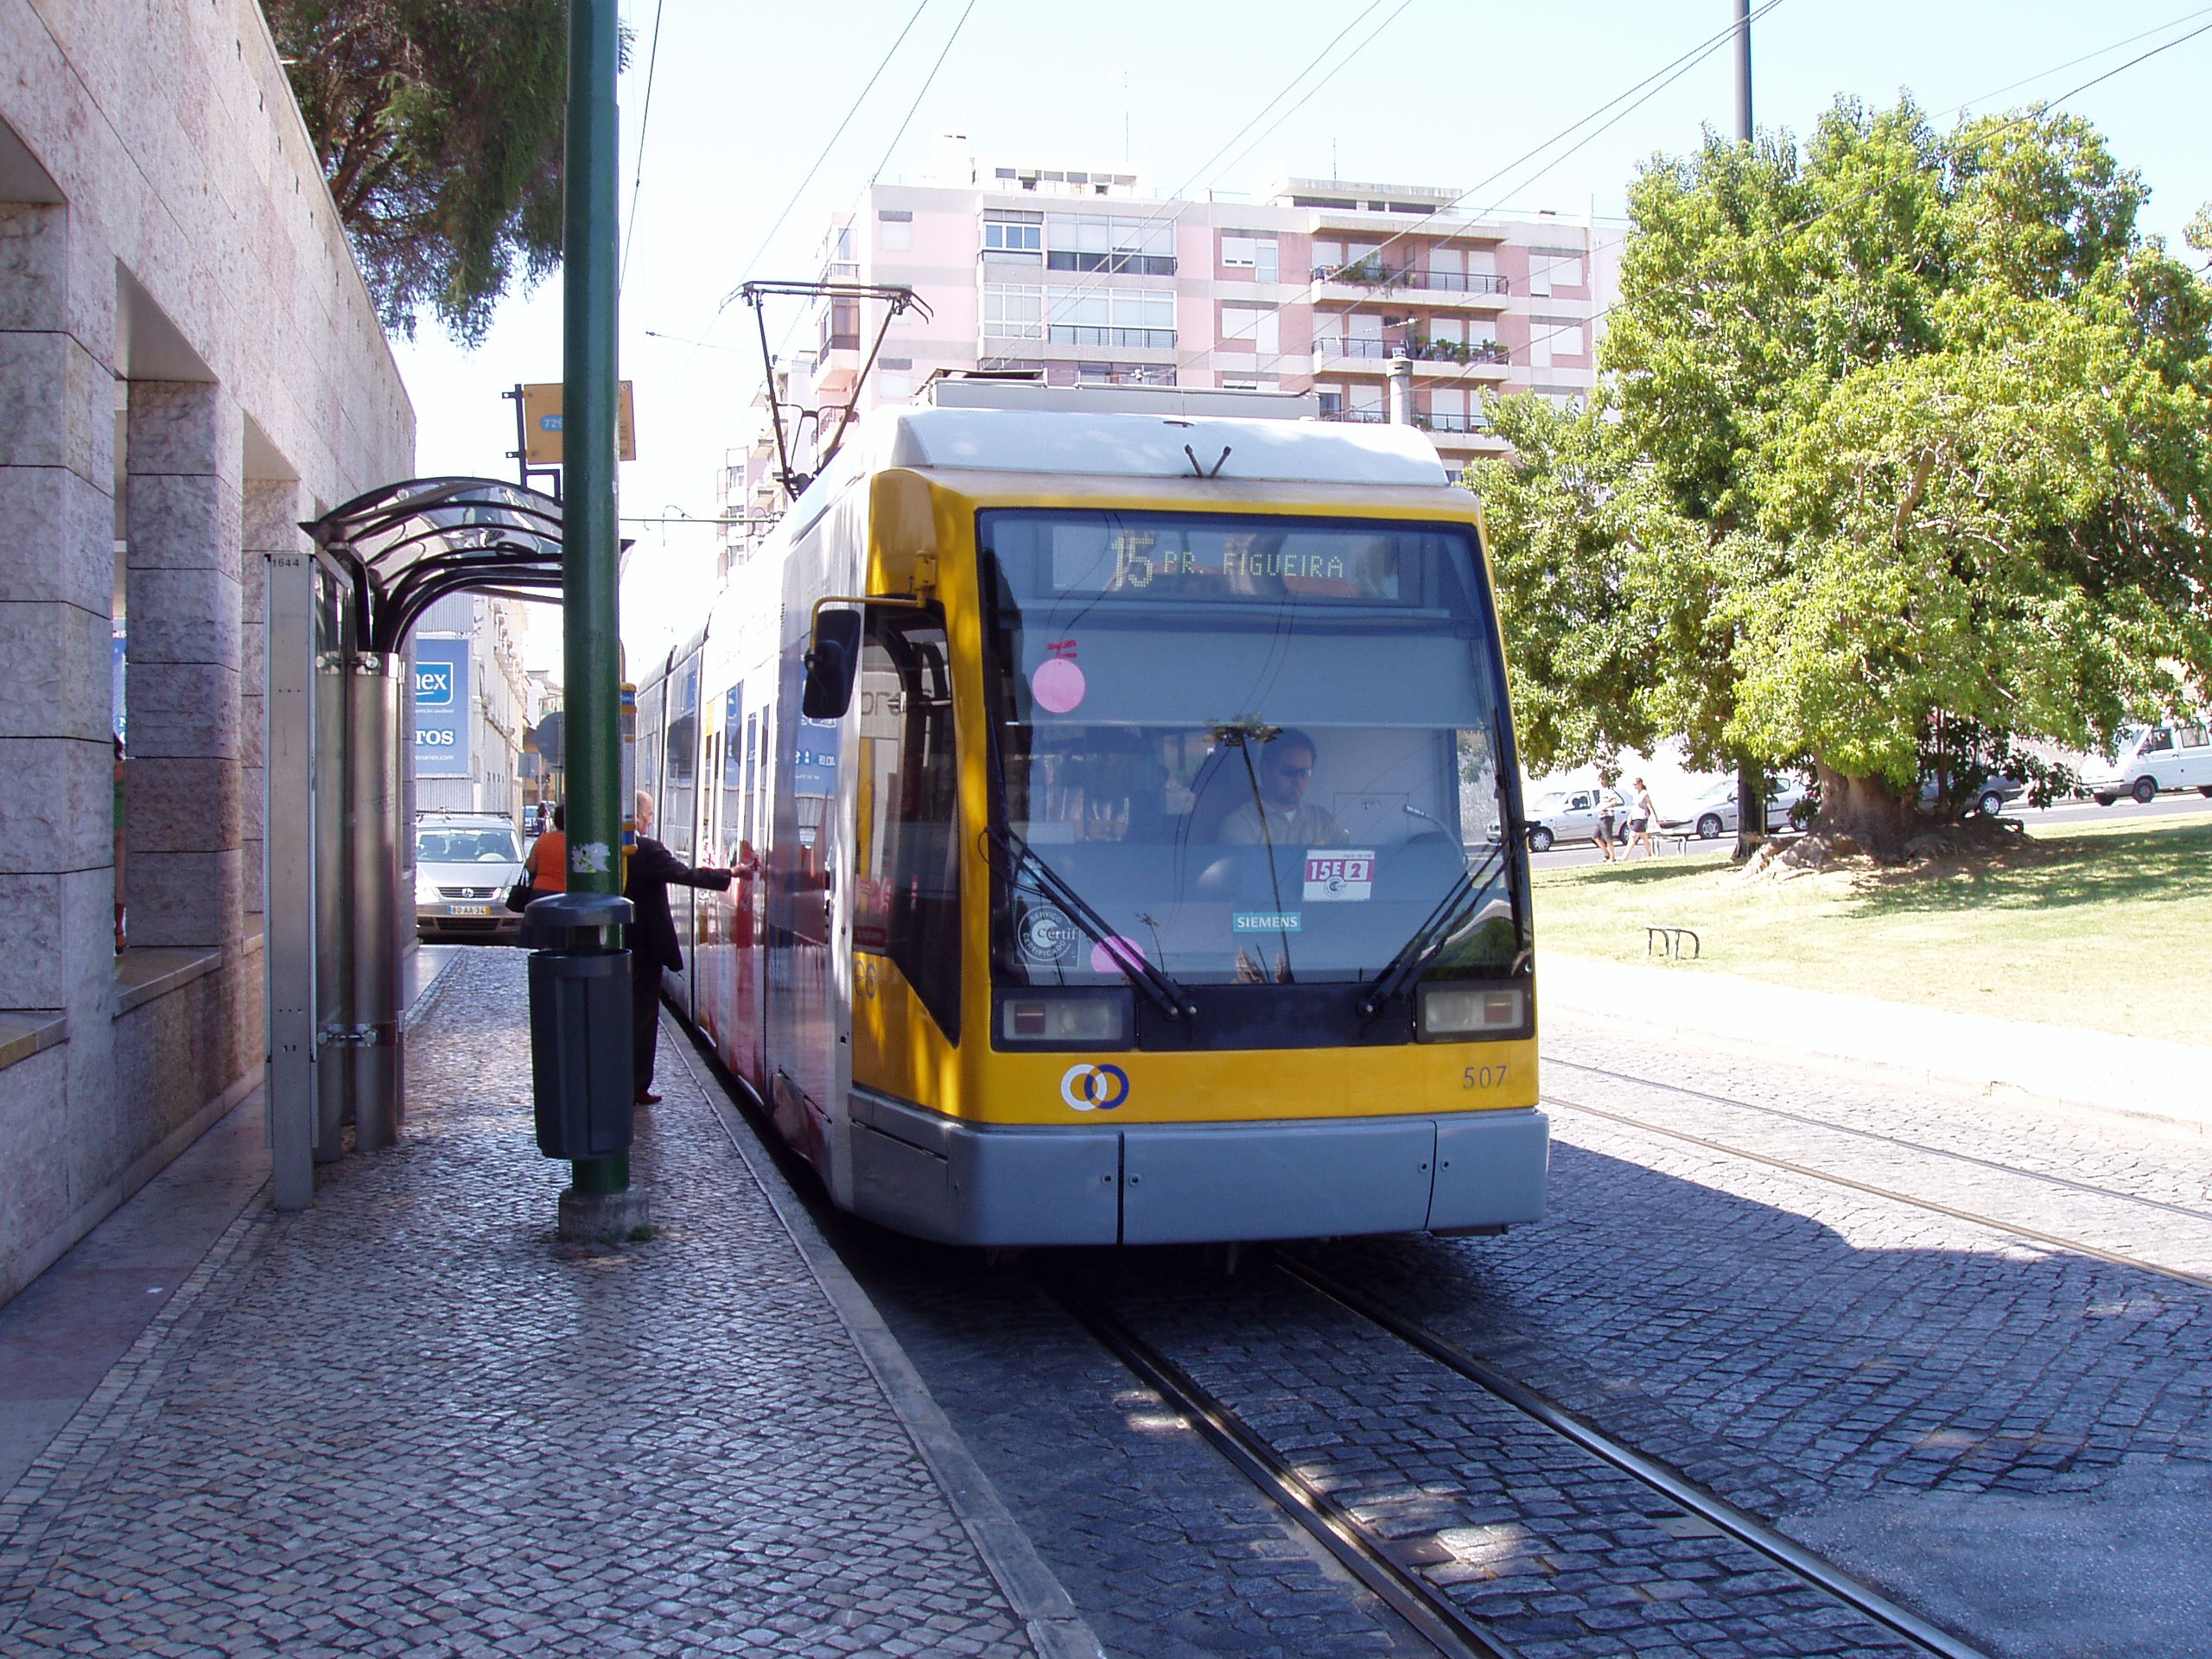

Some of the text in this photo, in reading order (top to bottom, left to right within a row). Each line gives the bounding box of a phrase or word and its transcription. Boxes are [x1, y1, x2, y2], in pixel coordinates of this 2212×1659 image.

[272, 558, 299, 568] 1644
[1111, 537, 1343, 588] 15 PR. FIGUEIRA
[1311, 861, 1362, 880] 15E 2
[1236, 916, 1299, 928] SIEMENS
[1463, 1065, 1508, 1090] 507
